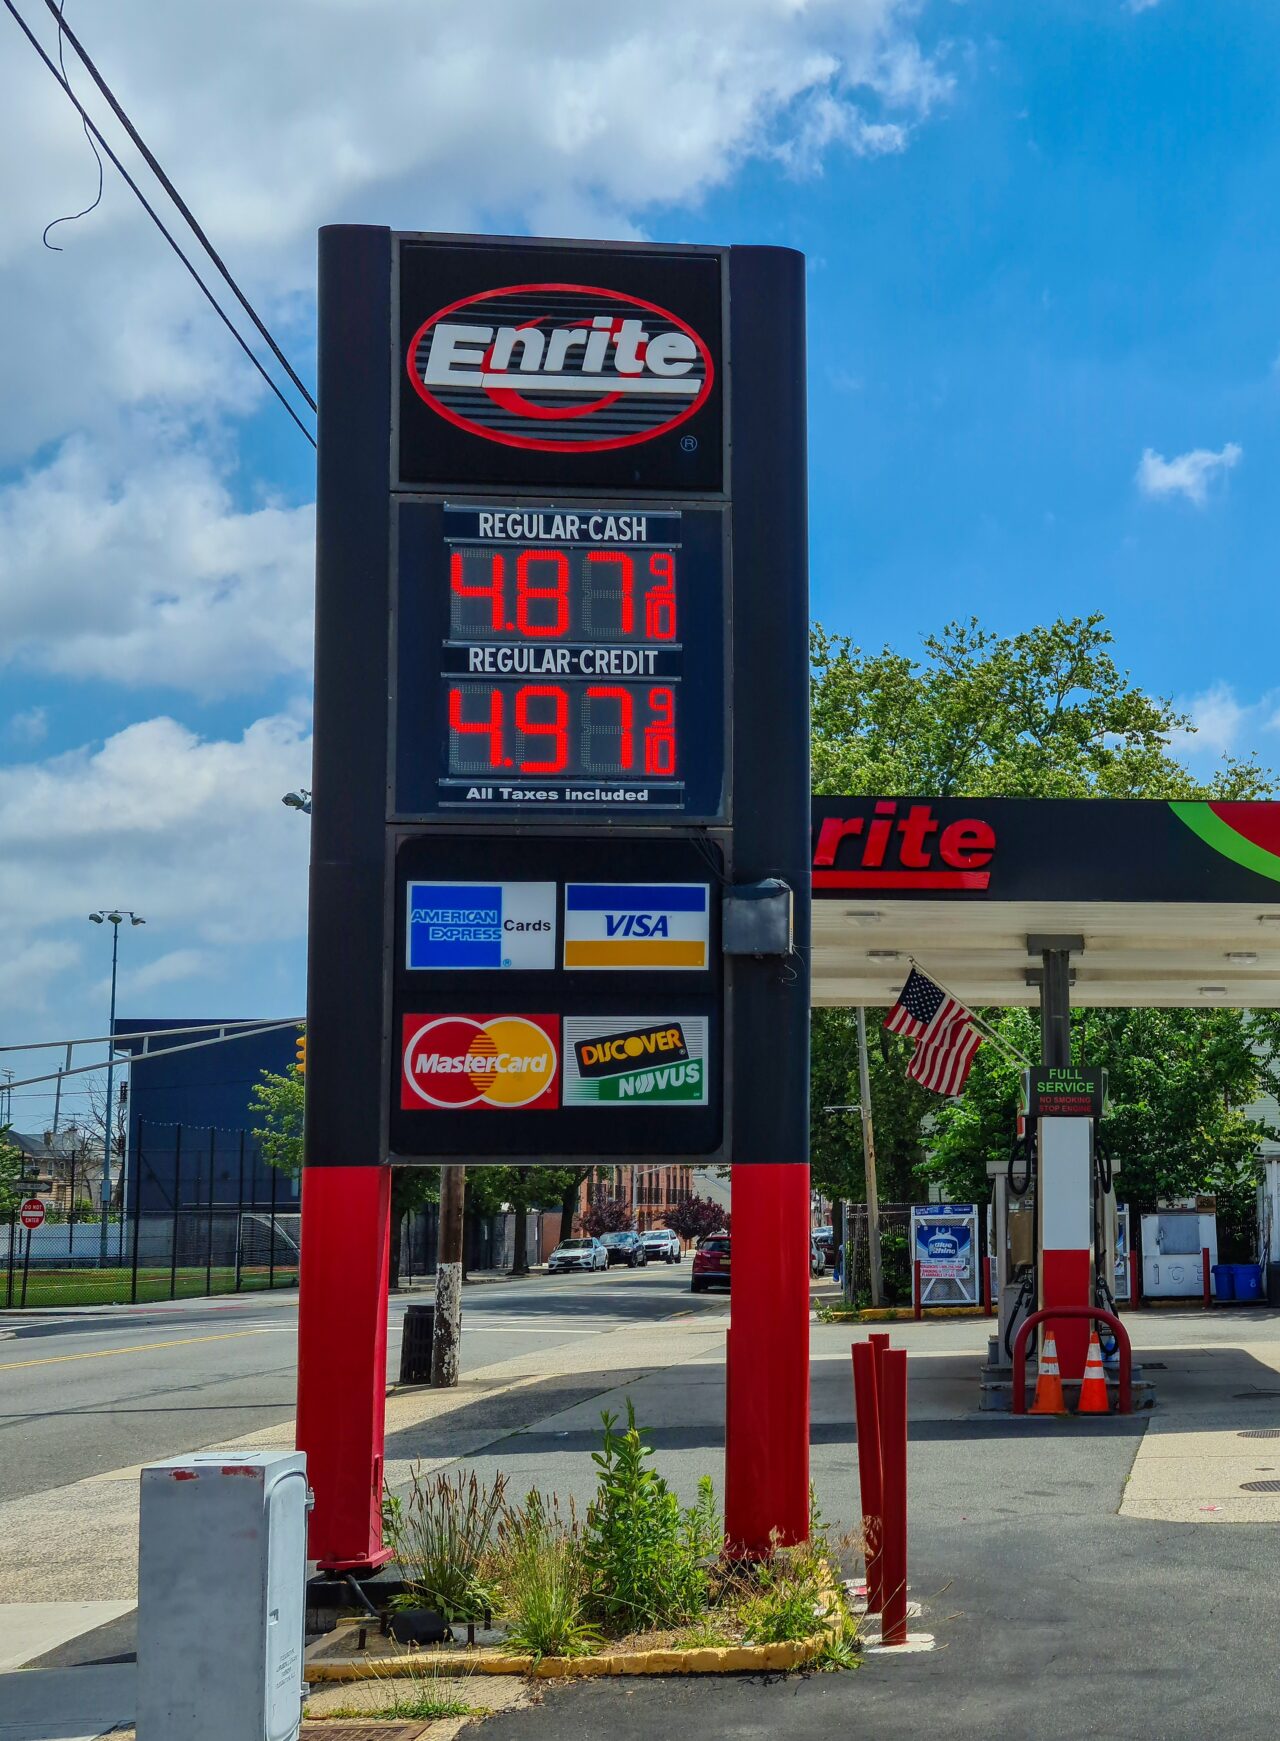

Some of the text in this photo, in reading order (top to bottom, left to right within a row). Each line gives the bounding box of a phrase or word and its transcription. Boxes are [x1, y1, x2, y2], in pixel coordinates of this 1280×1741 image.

[424, 316, 699, 387] Enrite
[466, 788, 649, 801] All Taxes included
[811, 800, 997, 870] rite
[411, 909, 497, 924] AMERICAN
[503, 919, 551, 932] Cards
[604, 914, 670, 937] VISA
[429, 927, 502, 941] EXPRESS
[580, 1028, 684, 1066] DISCOVER
[414, 1053, 548, 1074] MasterCard
[618, 1063, 701, 1098] NOVUS
[1049, 1068, 1083, 1079] FULL
[1037, 1082, 1095, 1093] SERVICE
